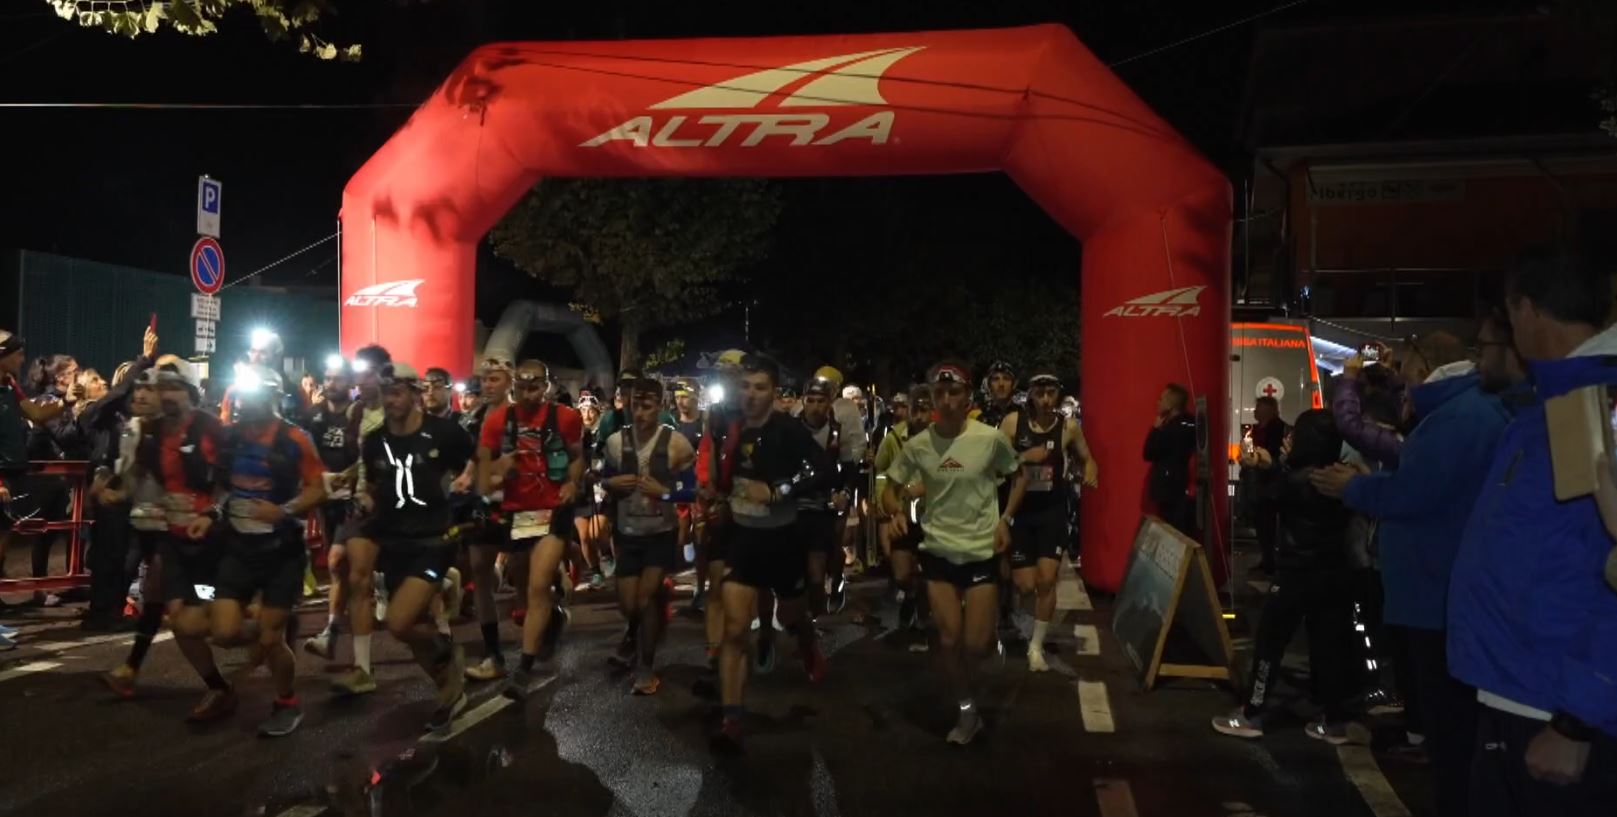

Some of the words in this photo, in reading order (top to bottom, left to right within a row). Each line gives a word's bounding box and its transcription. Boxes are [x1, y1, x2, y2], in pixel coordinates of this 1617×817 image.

[578, 111, 895, 148] ALTRA
[205, 186, 216, 208] P
[345, 295, 418, 308] ALTRA
[1103, 305, 1201, 317] ALTRA
[1257, 338, 1307, 349] ITALIANA
